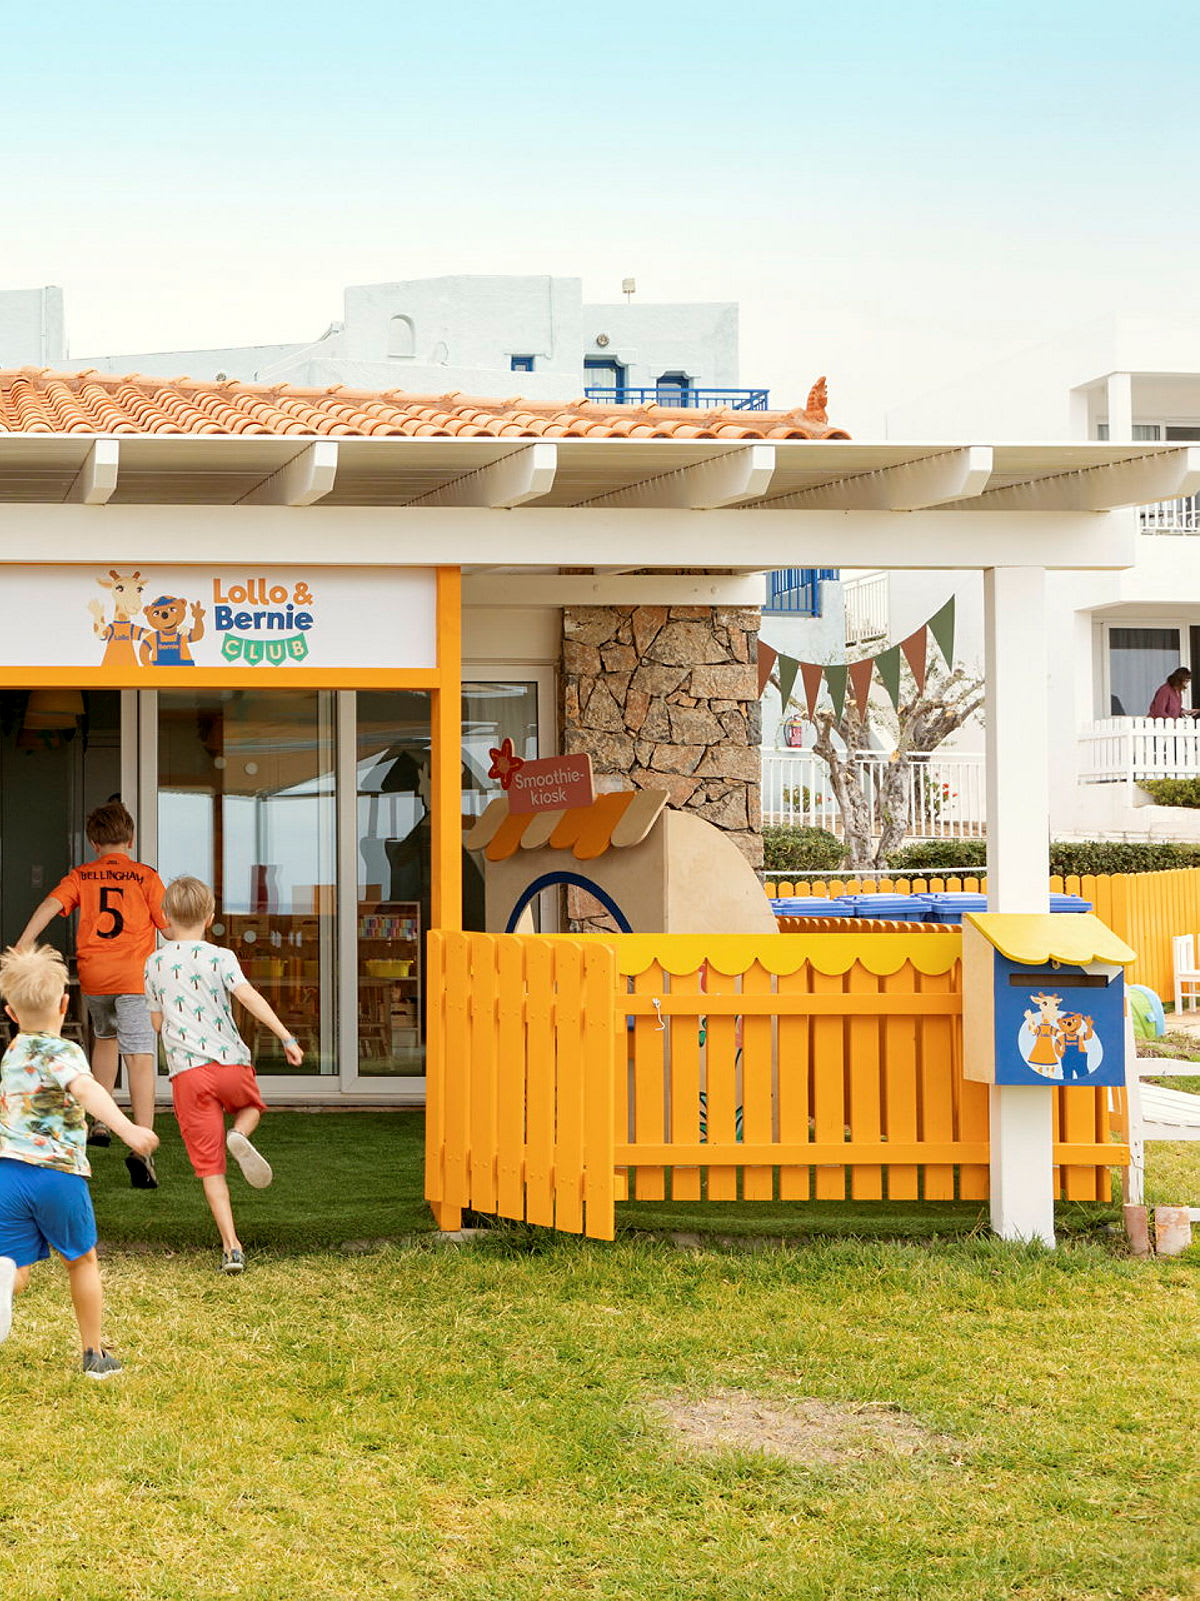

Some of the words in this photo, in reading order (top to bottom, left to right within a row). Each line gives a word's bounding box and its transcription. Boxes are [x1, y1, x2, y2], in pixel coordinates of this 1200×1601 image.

[213, 578, 288, 605] Lollo
[293, 582, 314, 606] &
[215, 603, 314, 631] Bernie
[224, 638, 305, 660] CLUB
[514, 767, 585, 789] Smoothie-
[530, 787, 567, 806] kiosk
[97, 887, 124, 939] 5
